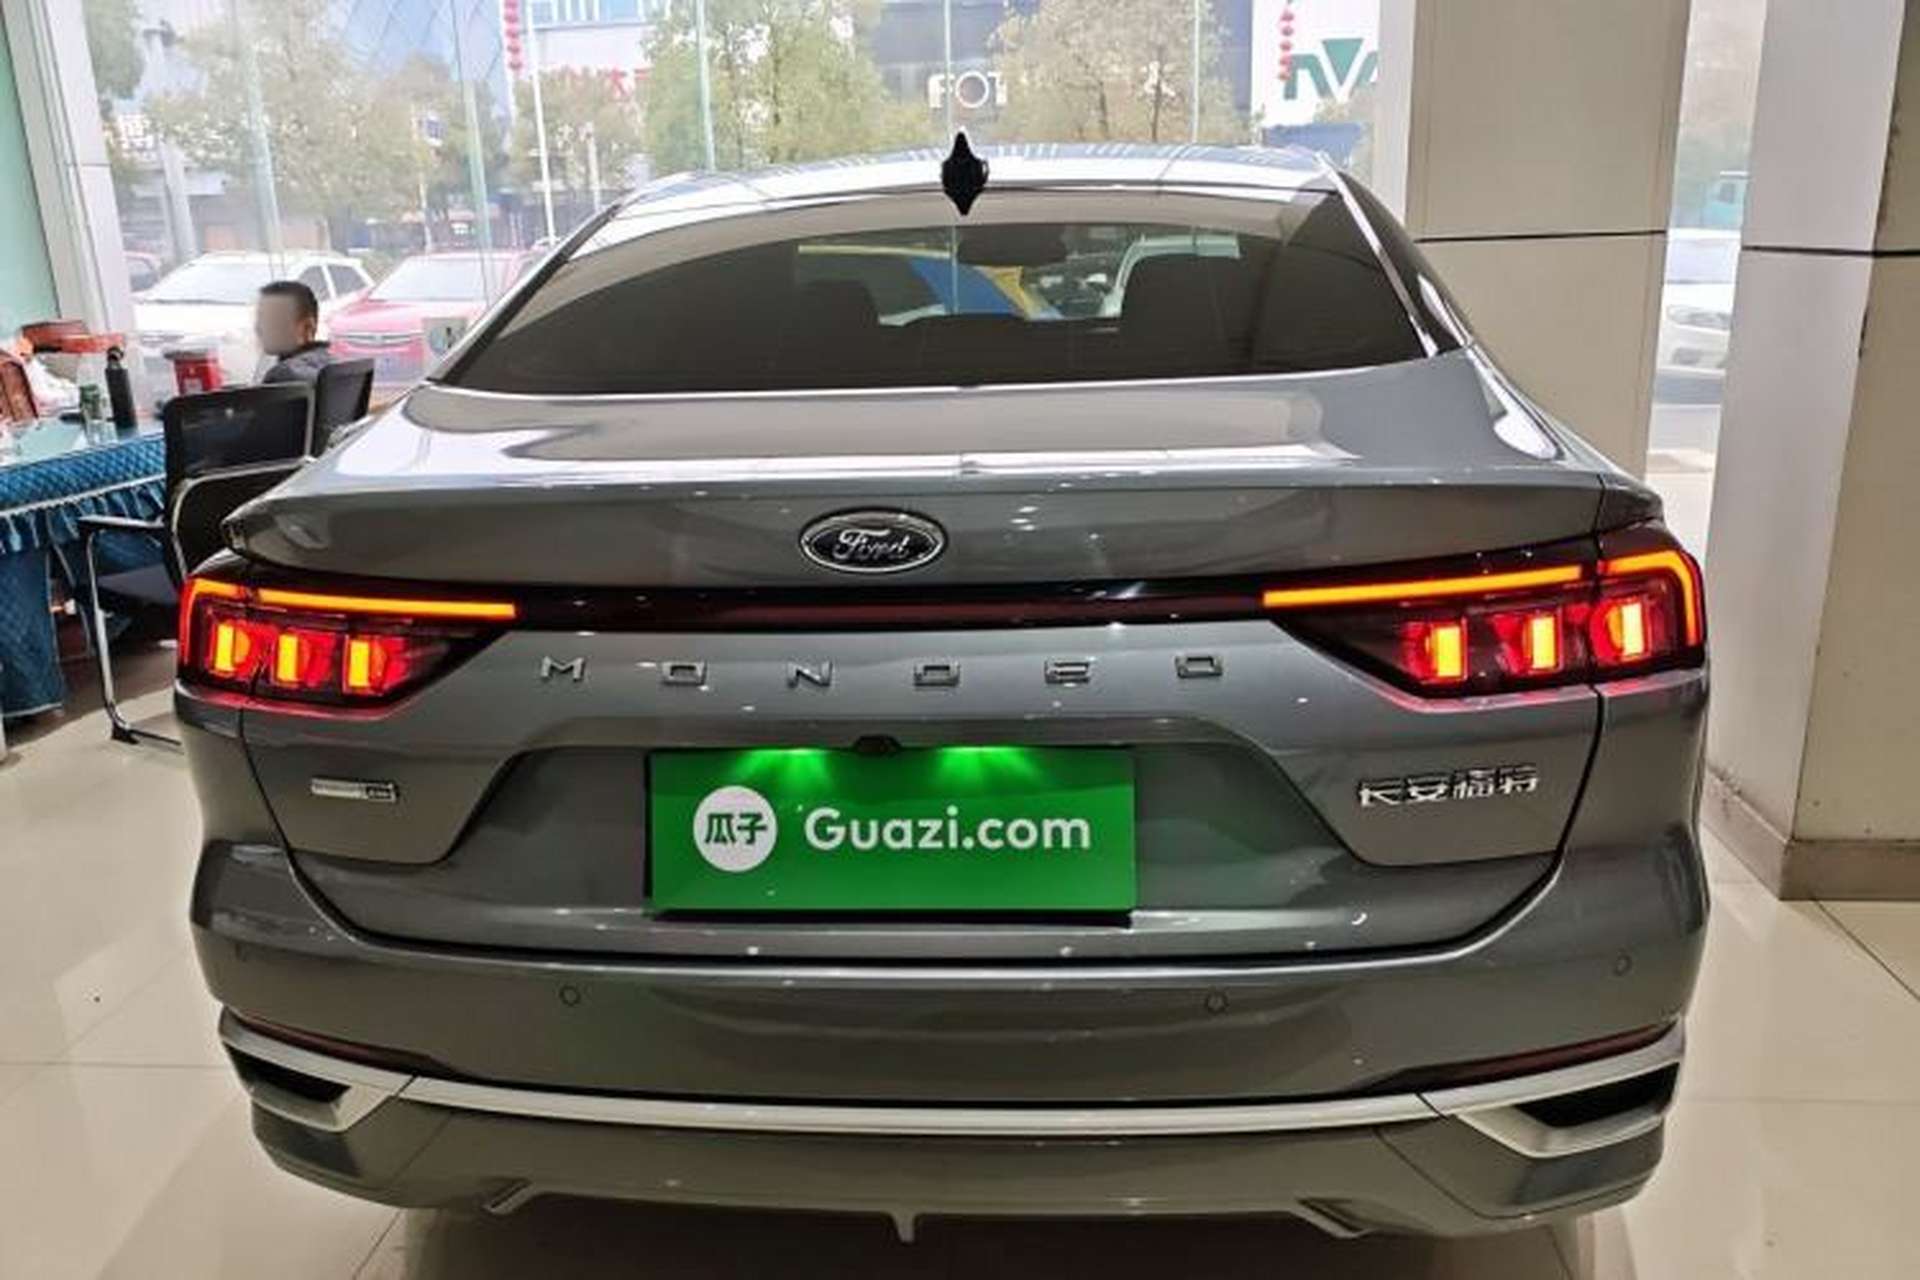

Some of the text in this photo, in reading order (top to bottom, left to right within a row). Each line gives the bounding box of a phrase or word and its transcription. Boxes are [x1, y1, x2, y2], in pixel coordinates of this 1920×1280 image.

[833, 528, 911, 560] Ford
[540, 656, 1225, 688] MONDEO
[1359, 766, 1539, 807] 长安福特
[704, 812, 768, 845] 瓜子
[804, 805, 1091, 850] Guazi.com
